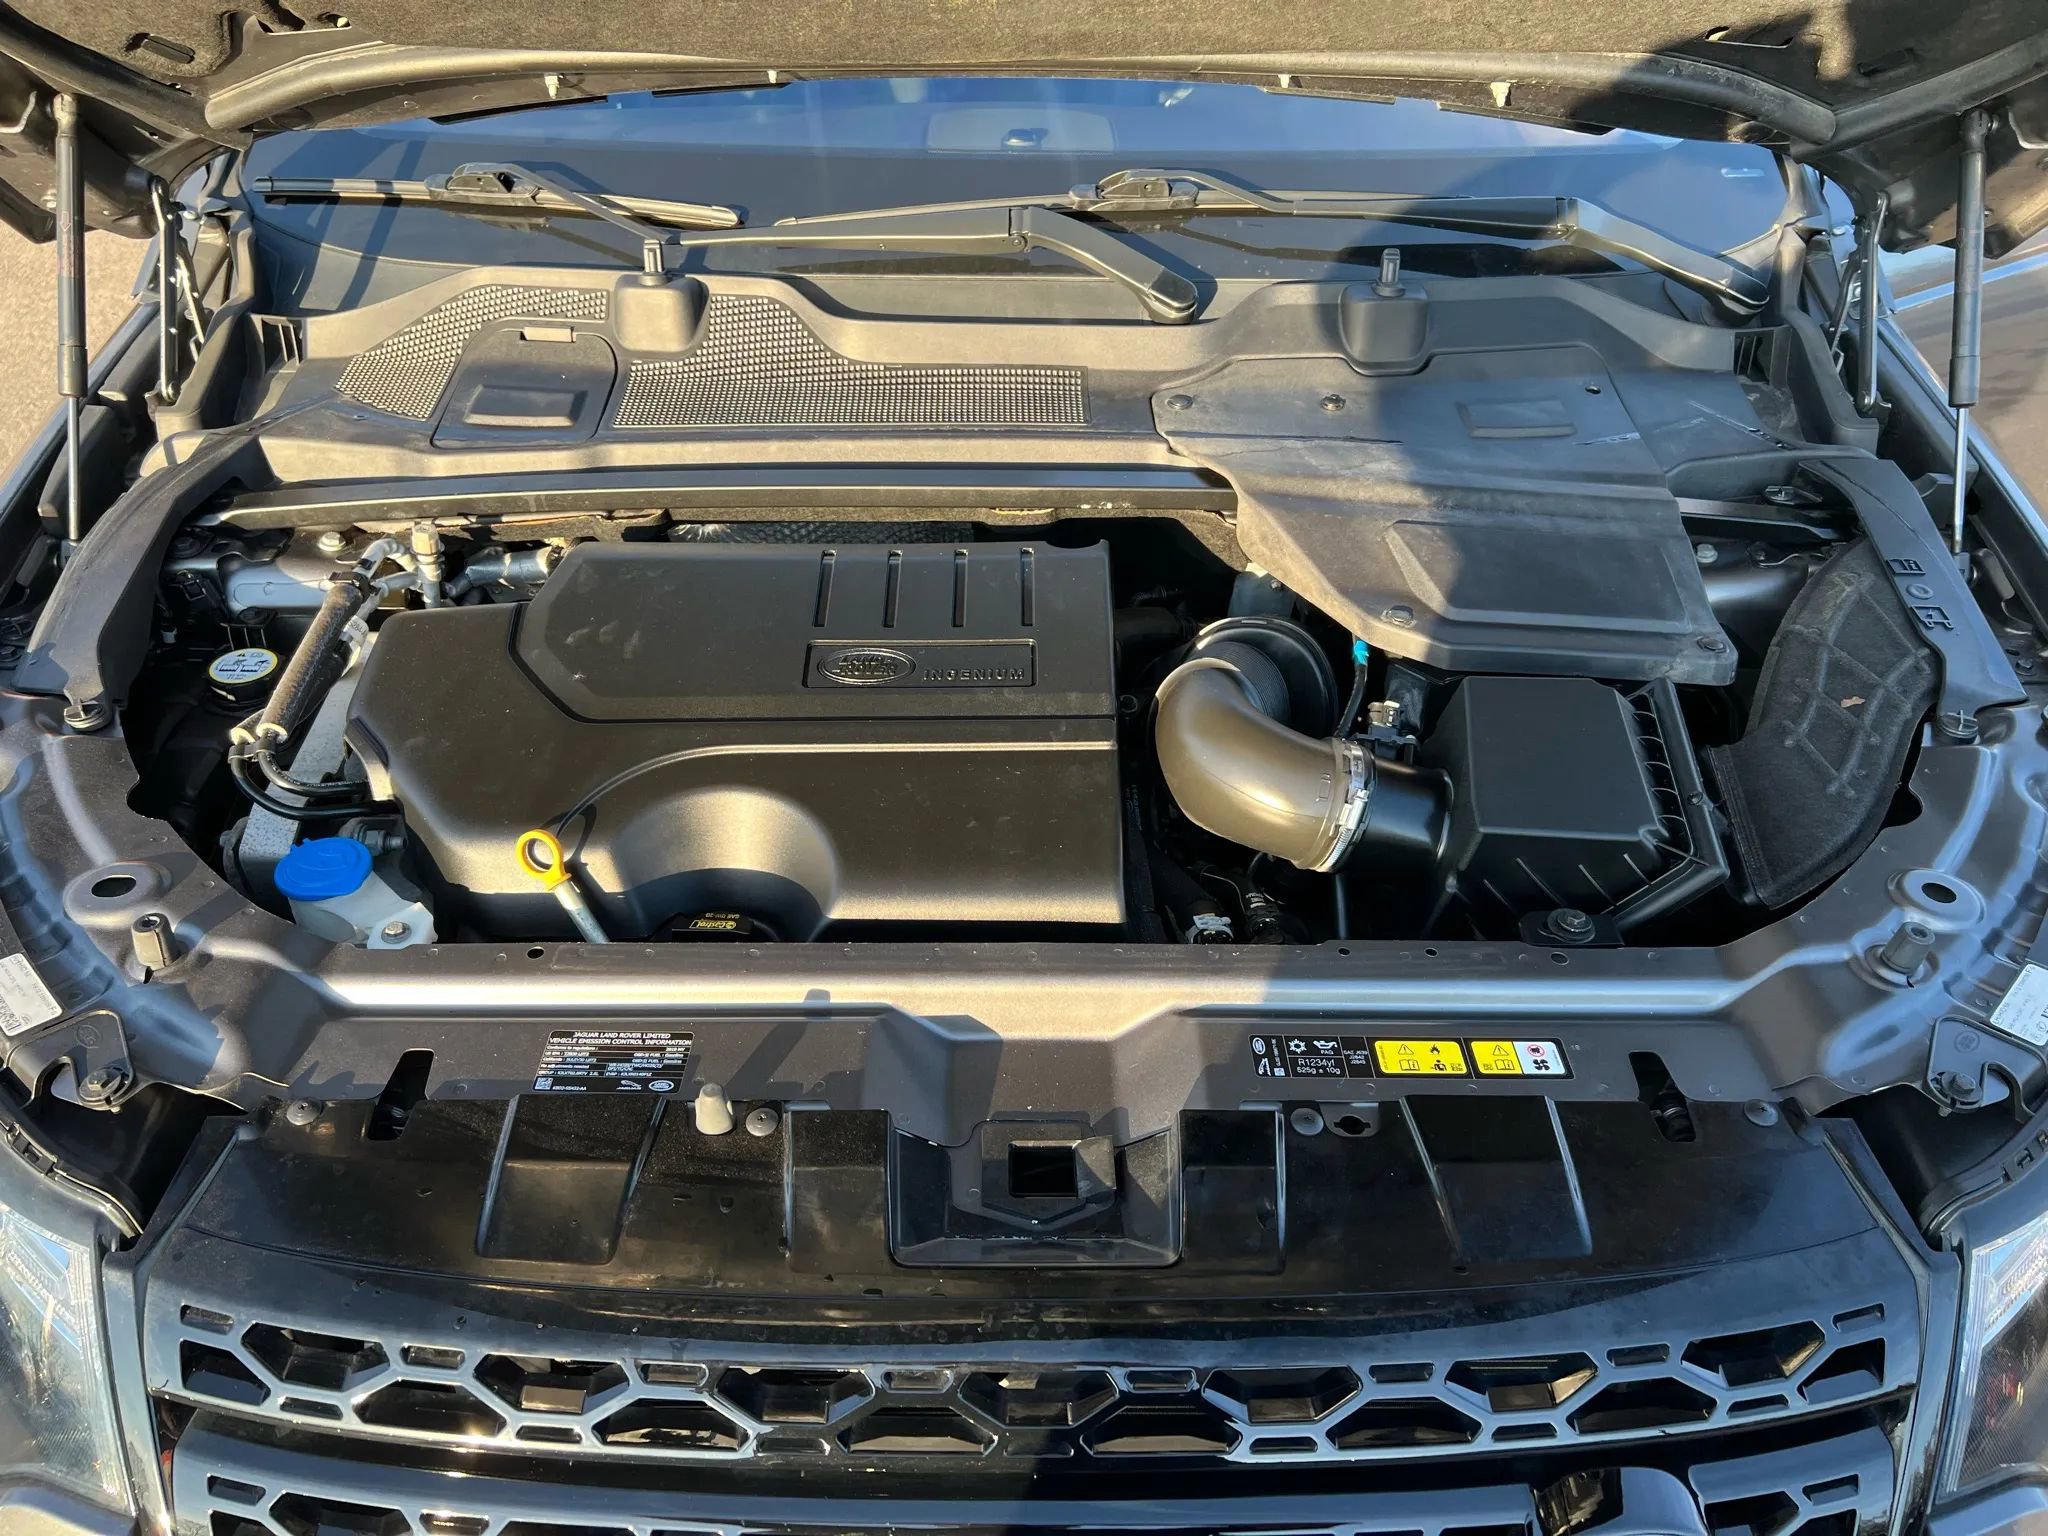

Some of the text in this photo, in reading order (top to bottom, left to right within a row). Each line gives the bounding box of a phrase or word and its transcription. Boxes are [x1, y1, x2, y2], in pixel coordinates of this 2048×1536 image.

[922, 667, 1025, 681] INGENIUM
[697, 920, 726, 928] Castrol
[1298, 1058, 1335, 1068] R1234yf
[1296, 1066, 1317, 1075] 525g
[1326, 1066, 1341, 1075] 10g
